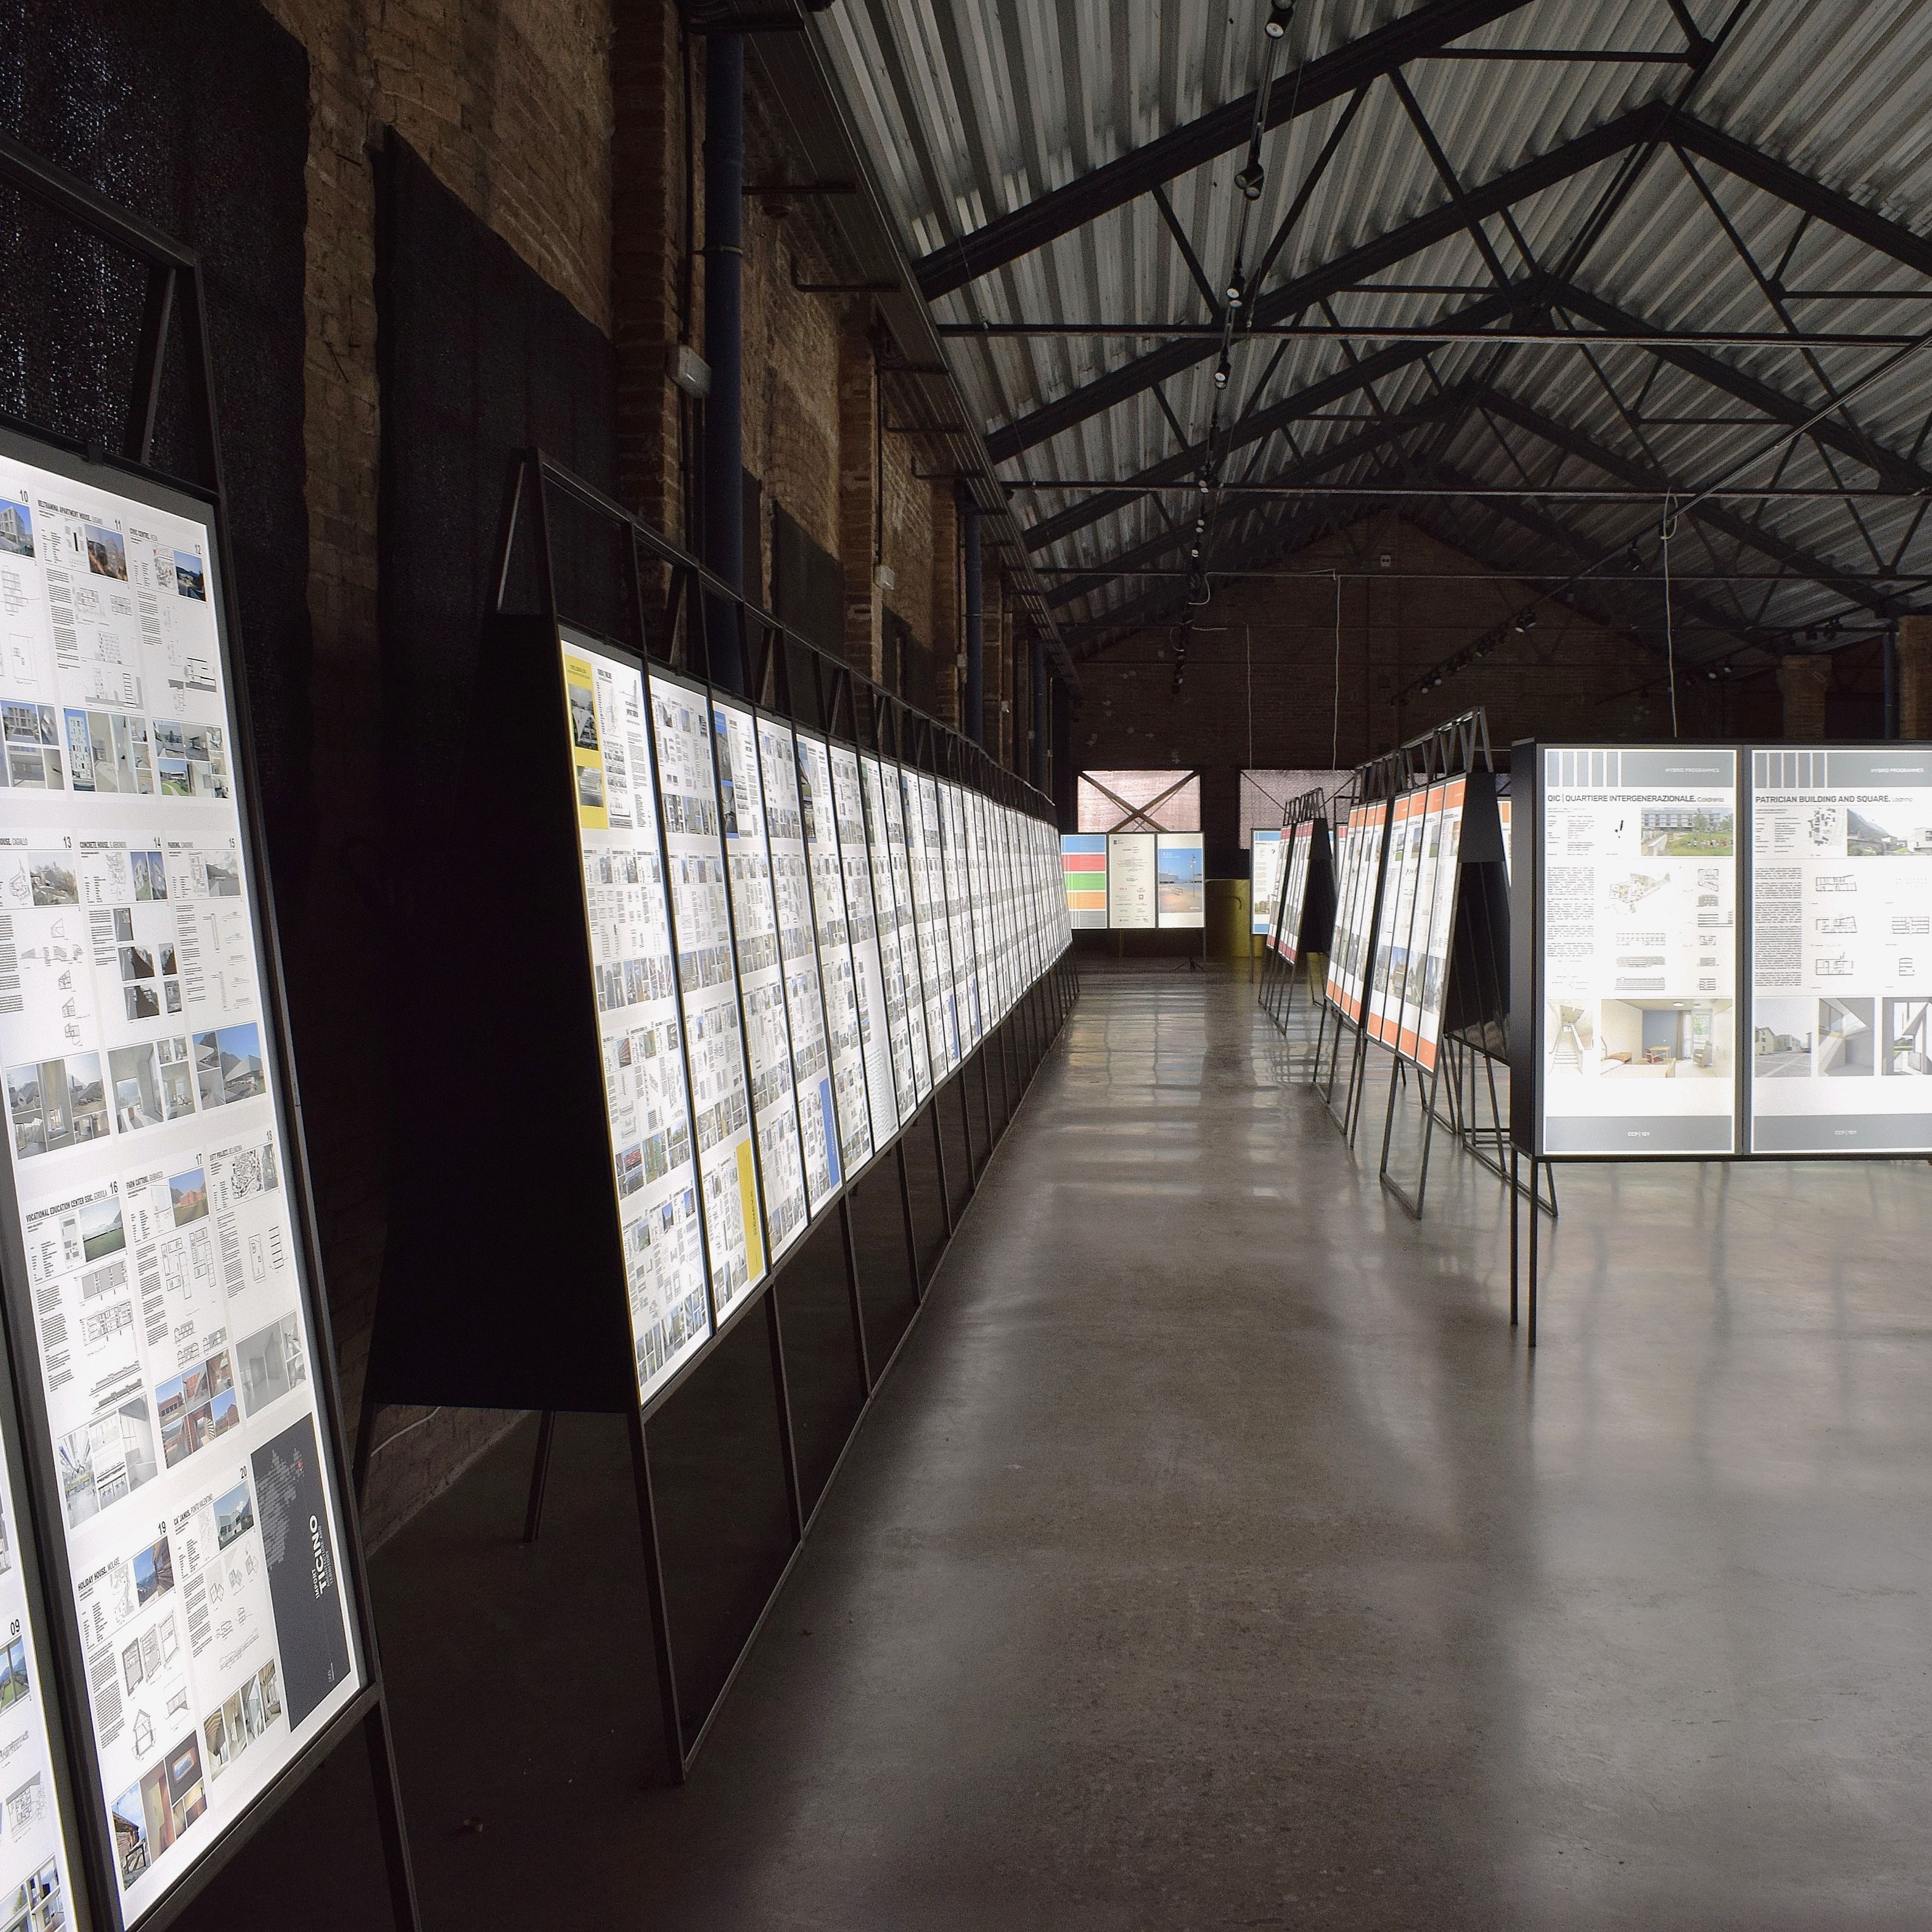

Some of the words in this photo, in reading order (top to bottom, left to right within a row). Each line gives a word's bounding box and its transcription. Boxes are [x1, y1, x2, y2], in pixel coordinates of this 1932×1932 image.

[19, 490, 29, 502] 10
[60, 506, 79, 518] APARTMENT
[114, 519, 122, 531] 11
[195, 544, 201, 555] 12
[63, 836, 71, 848] 13
[154, 837, 161, 848] 14
[229, 838, 235, 848] 15
[196, 1153, 202, 1165] 17
[110, 1181, 118, 1194] 16
[26, 1209, 49, 1223] VOCATIONAL
[50, 1202, 70, 1214] EDUCATION
[70, 1197, 85, 1208] CENTER
[240, 1466, 247, 1479] 20
[158, 1521, 166, 1535] 19
[309, 1515, 327, 1594] TICINO
[320, 1540, 331, 1587] ARCHITECTURE
[325, 1550, 333, 1584] TERRITORY
[78, 1574, 93, 1591] HOLIDAY
[311, 1568, 320, 1599] IMPORT
[10, 1619, 20, 1635] 09
